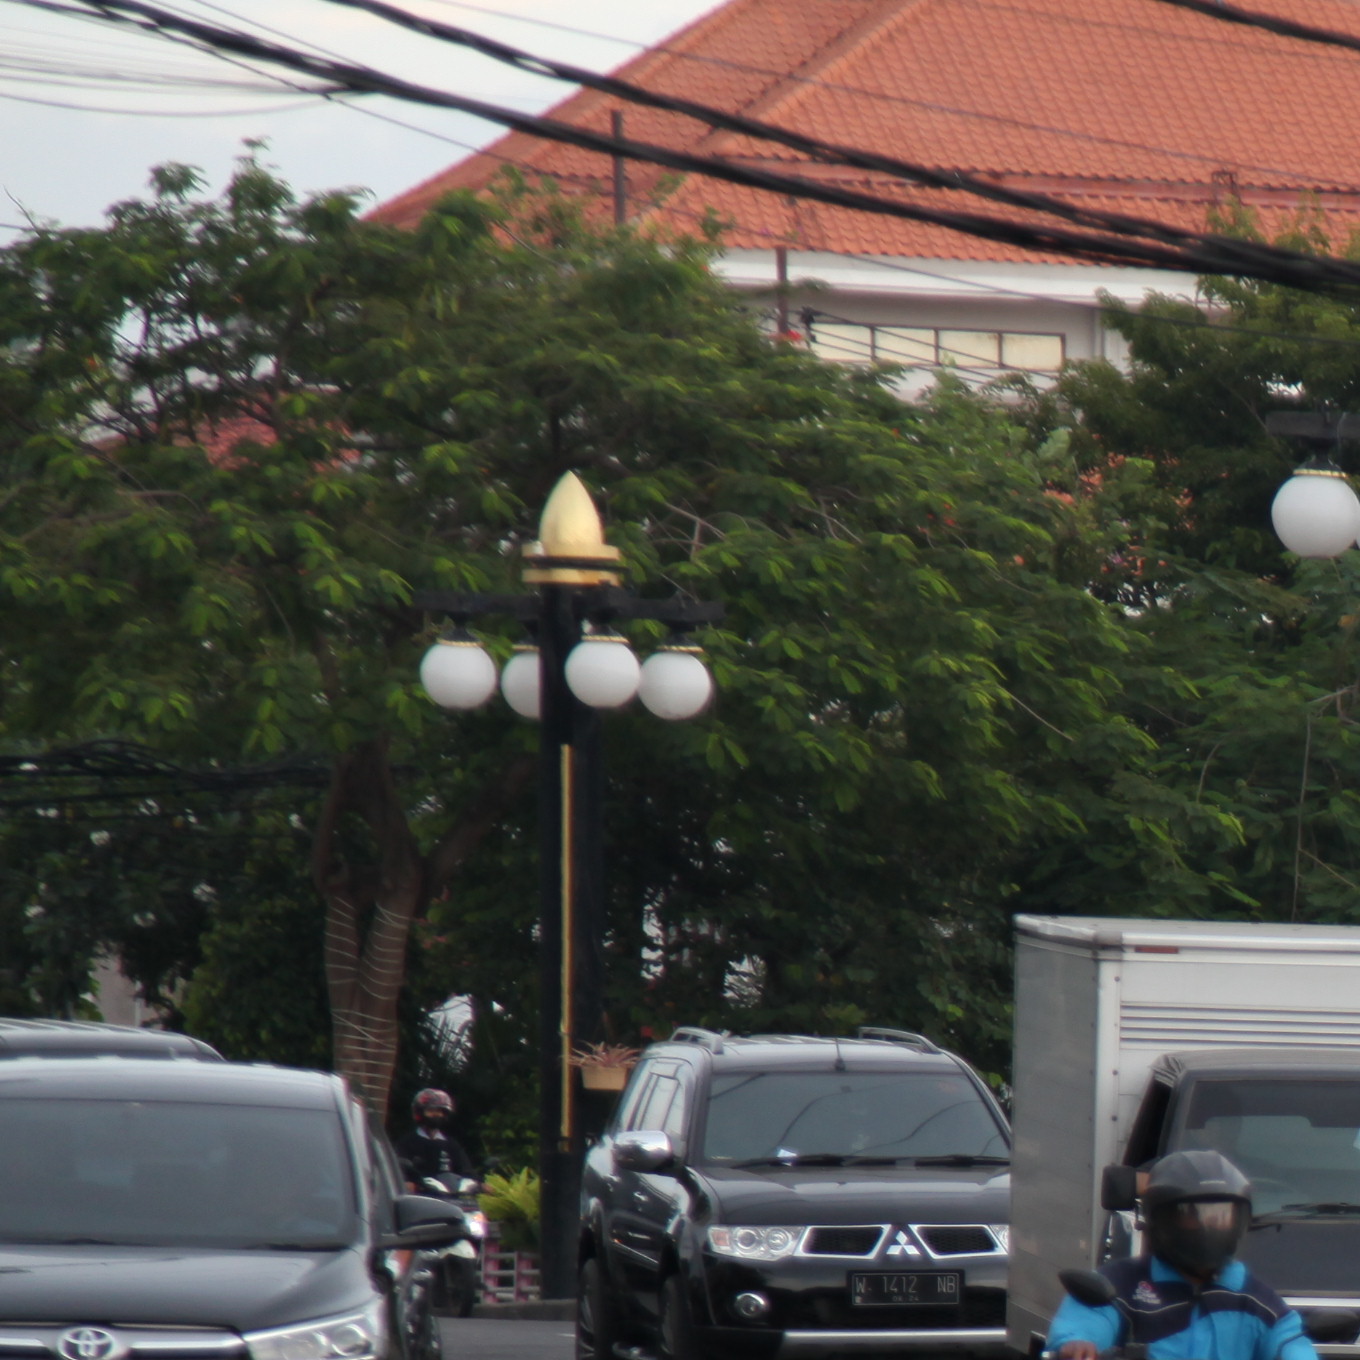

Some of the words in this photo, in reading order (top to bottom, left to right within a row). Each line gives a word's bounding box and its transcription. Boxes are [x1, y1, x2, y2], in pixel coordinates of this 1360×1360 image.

[855, 1276, 868, 1294] W
[883, 1275, 918, 1294] 1412
[937, 1275, 956, 1294] NB
